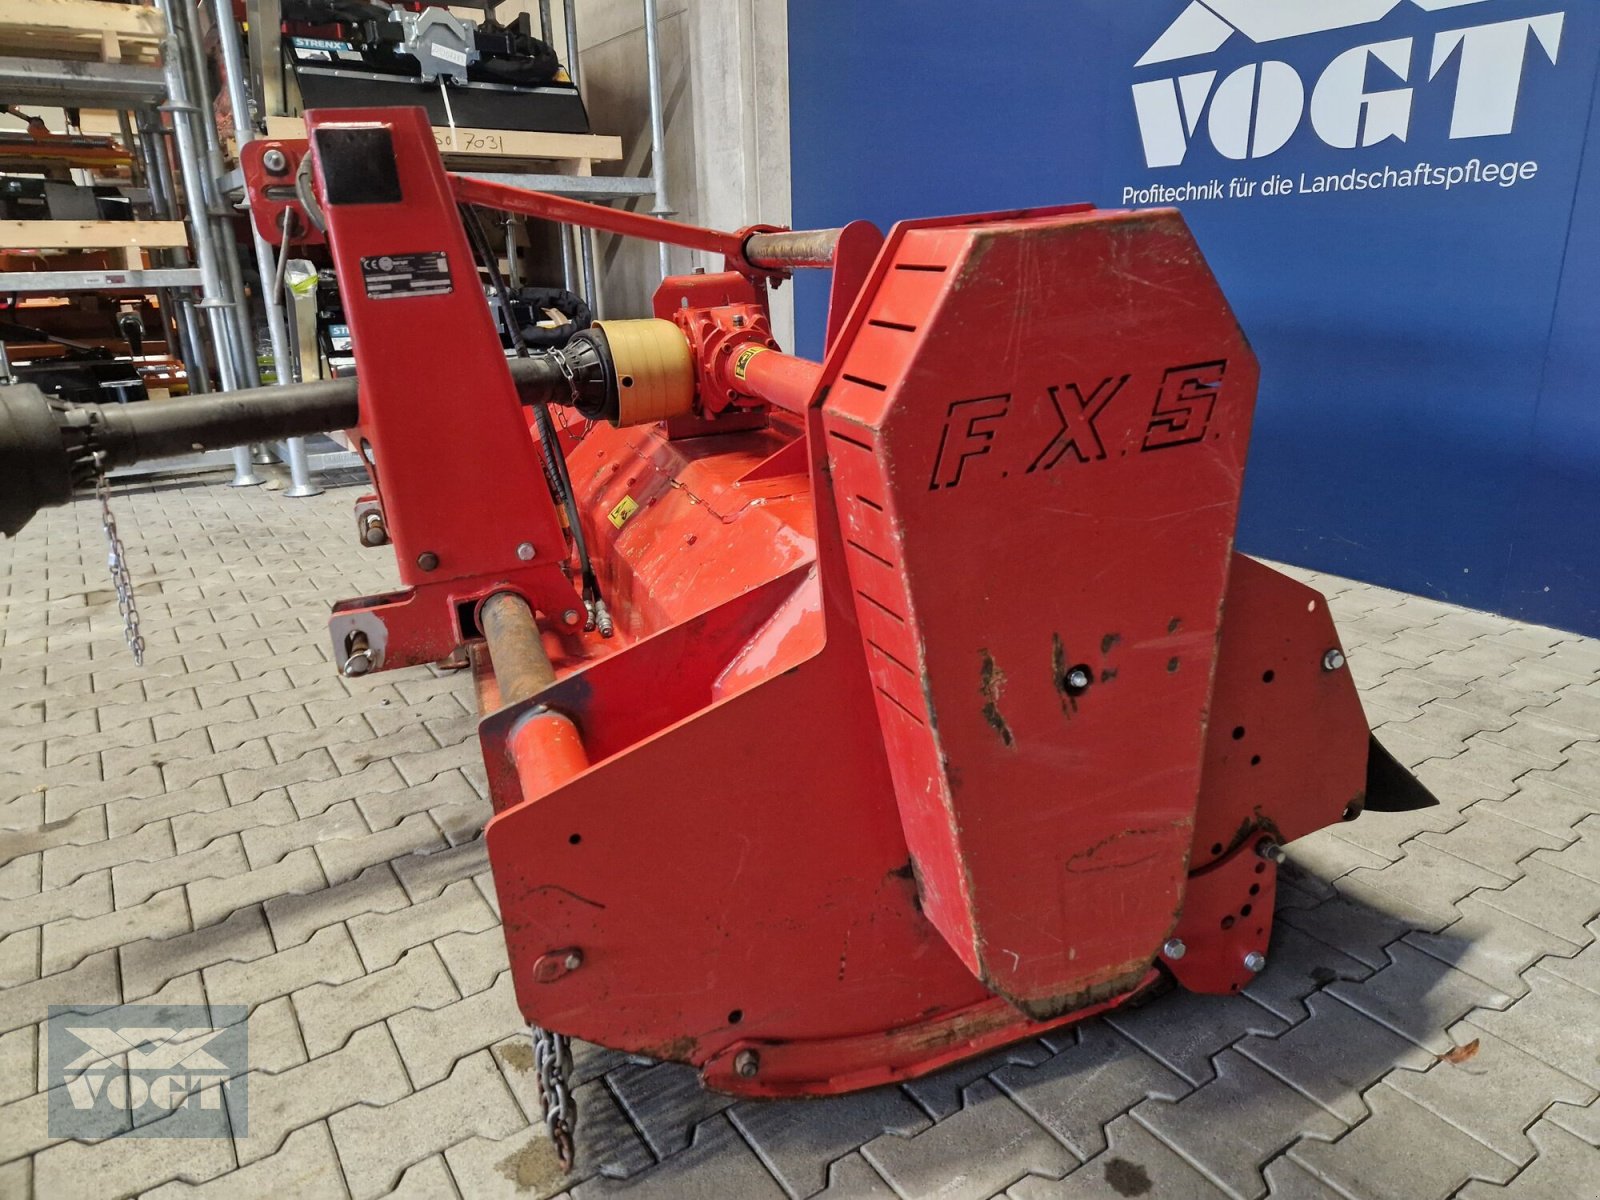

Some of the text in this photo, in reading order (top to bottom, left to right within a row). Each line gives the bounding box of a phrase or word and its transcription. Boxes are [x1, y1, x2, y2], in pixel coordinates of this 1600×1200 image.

[296, 38, 341, 49] STRENX
[1131, 11, 1565, 168] VOGT
[463, 133, 503, 153] 7031
[1122, 158, 1538, 205] Profitechnik für die Landschaftspflege
